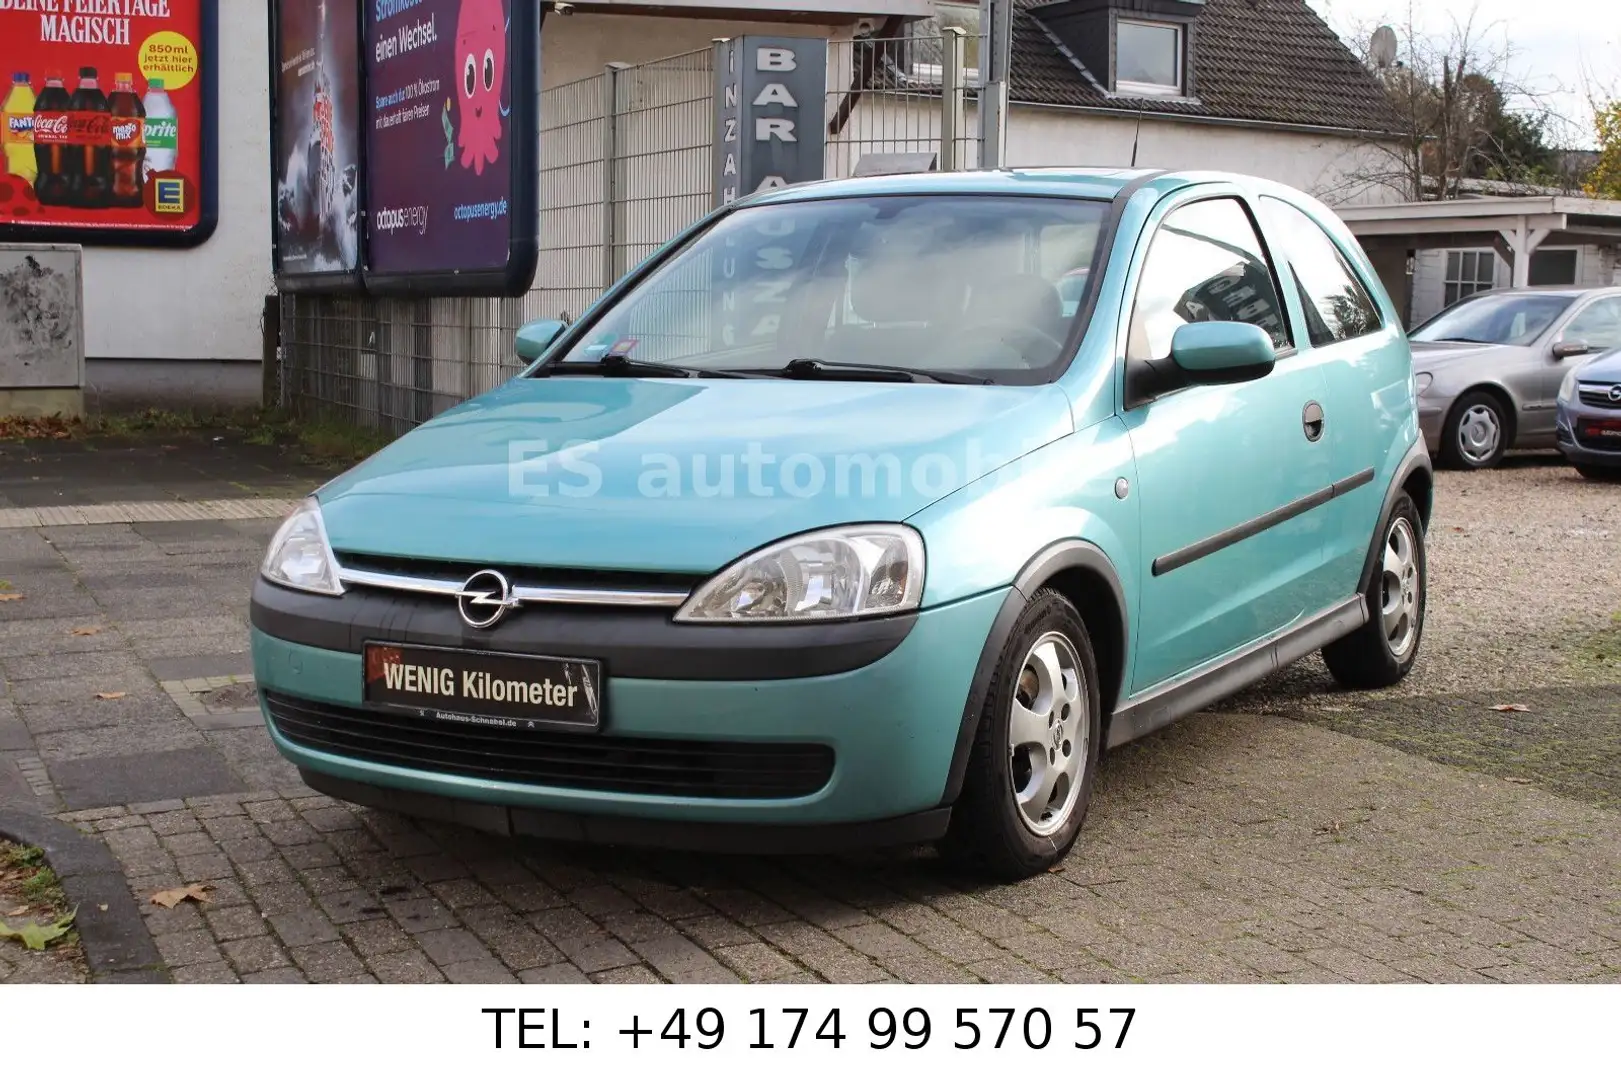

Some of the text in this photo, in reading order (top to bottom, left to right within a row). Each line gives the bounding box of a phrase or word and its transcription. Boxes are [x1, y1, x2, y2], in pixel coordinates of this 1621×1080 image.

[40, 14, 130, 45] MAGISCH
[375, 12, 437, 63] einen Wechsel.
[143, 53, 193, 64] jetzt hier
[142, 64, 194, 73] erhältlich
[9, 117, 35, 129] FANT
[144, 121, 177, 138] prite
[115, 130, 132, 140] mix
[454, 196, 507, 222] octopusenergy.de
[383, 662, 578, 707] WENIG Kilometer
